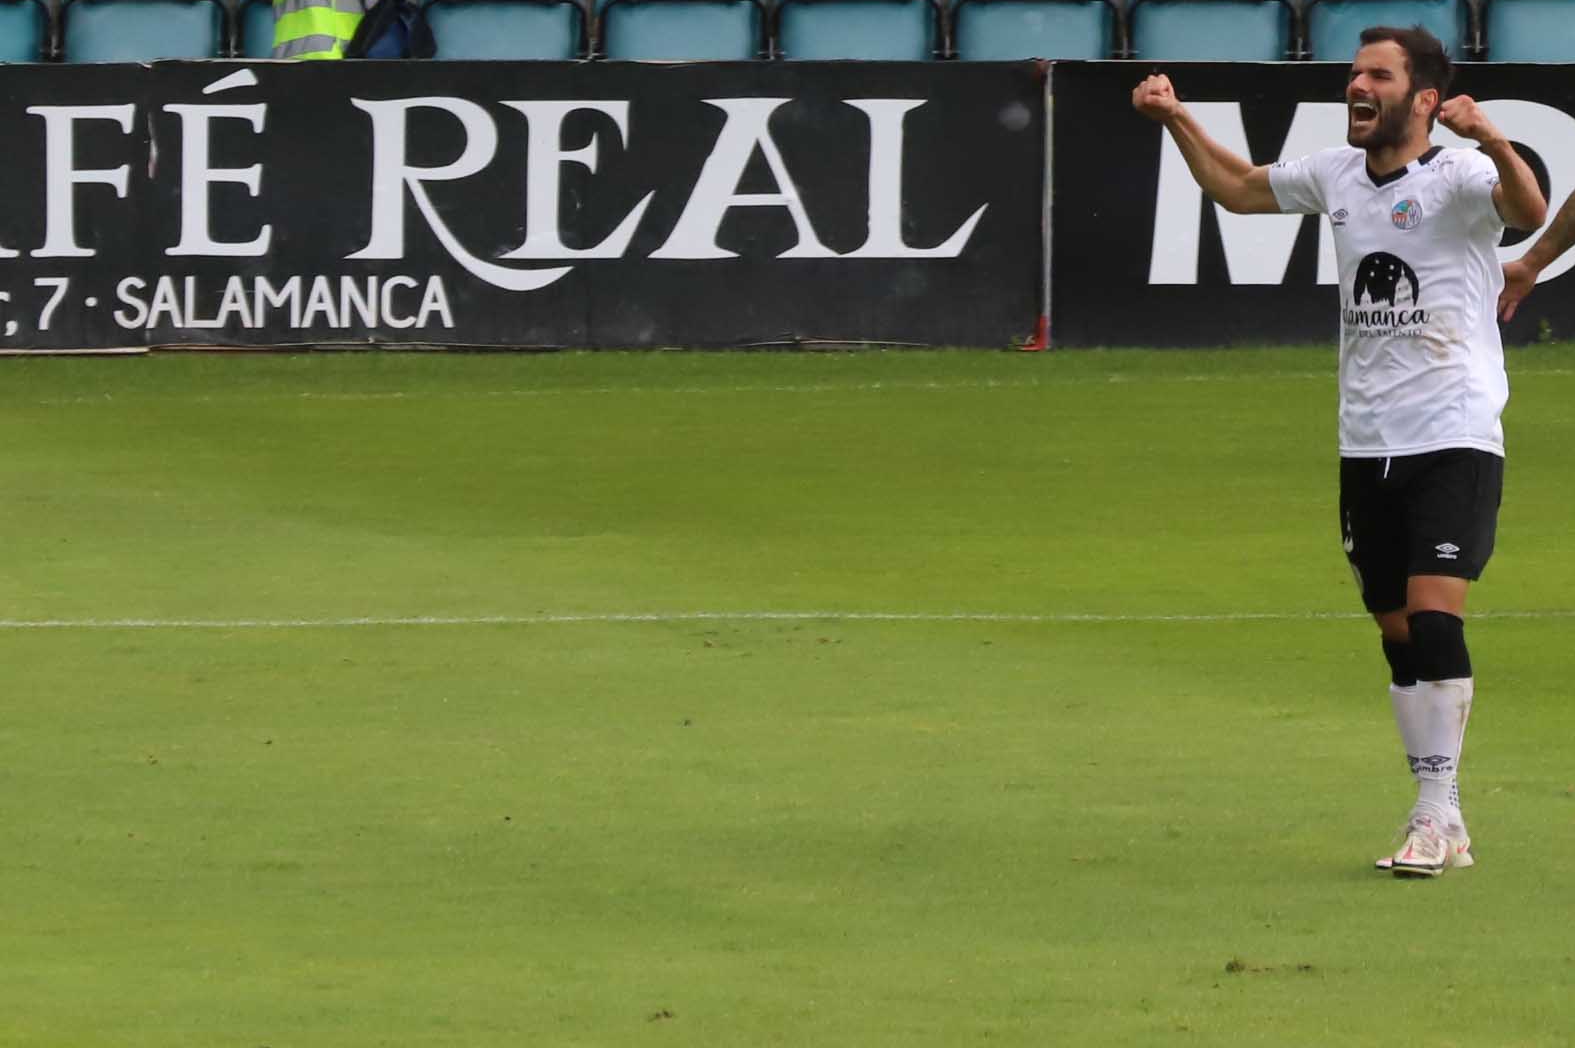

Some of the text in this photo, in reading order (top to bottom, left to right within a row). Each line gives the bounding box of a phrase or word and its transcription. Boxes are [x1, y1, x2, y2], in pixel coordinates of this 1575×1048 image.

[0, 68, 989, 293] FÉ REAL
[33, 277, 70, 331] 7
[113, 275, 455, 329] SALAMANCA
